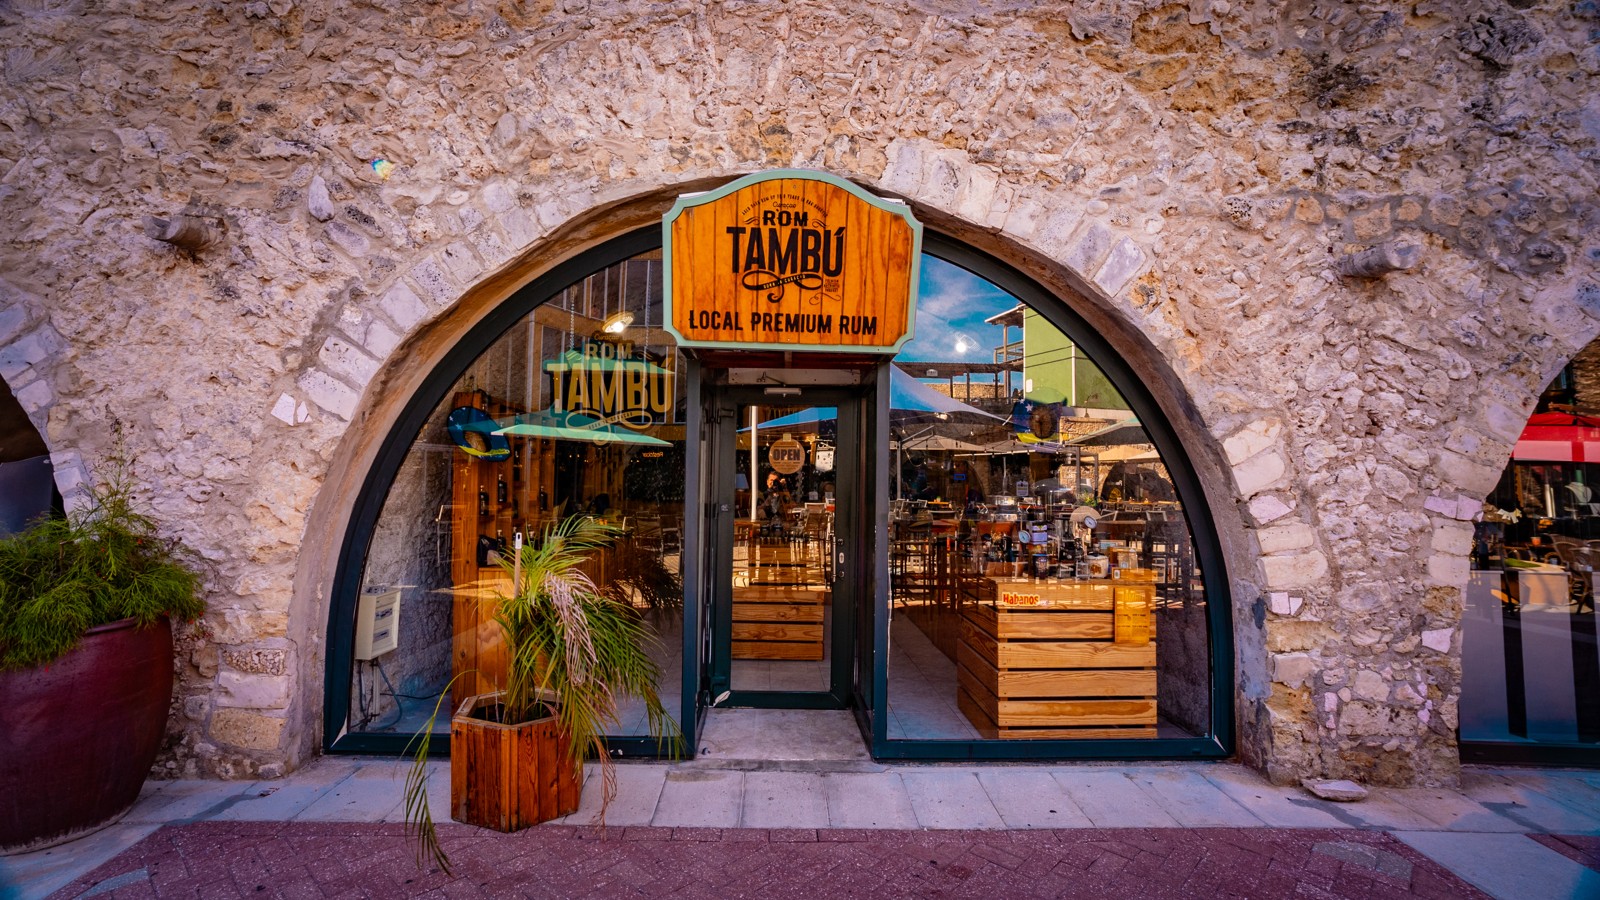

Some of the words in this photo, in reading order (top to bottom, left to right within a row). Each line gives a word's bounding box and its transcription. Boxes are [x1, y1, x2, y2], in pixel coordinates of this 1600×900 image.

[772, 201, 796, 210] Curaçao
[762, 210, 809, 227] ROM
[726, 226, 846, 277] TAMBÚ
[689, 310, 744, 331] LOCAL
[750, 312, 832, 334] PREMIUM
[838, 315, 877, 336] RUM
[584, 342, 632, 360] ROM
[546, 357, 674, 414] TAMBÚ
[773, 448, 800, 460] OPEN
[1002, 592, 1040, 605] Habanos
